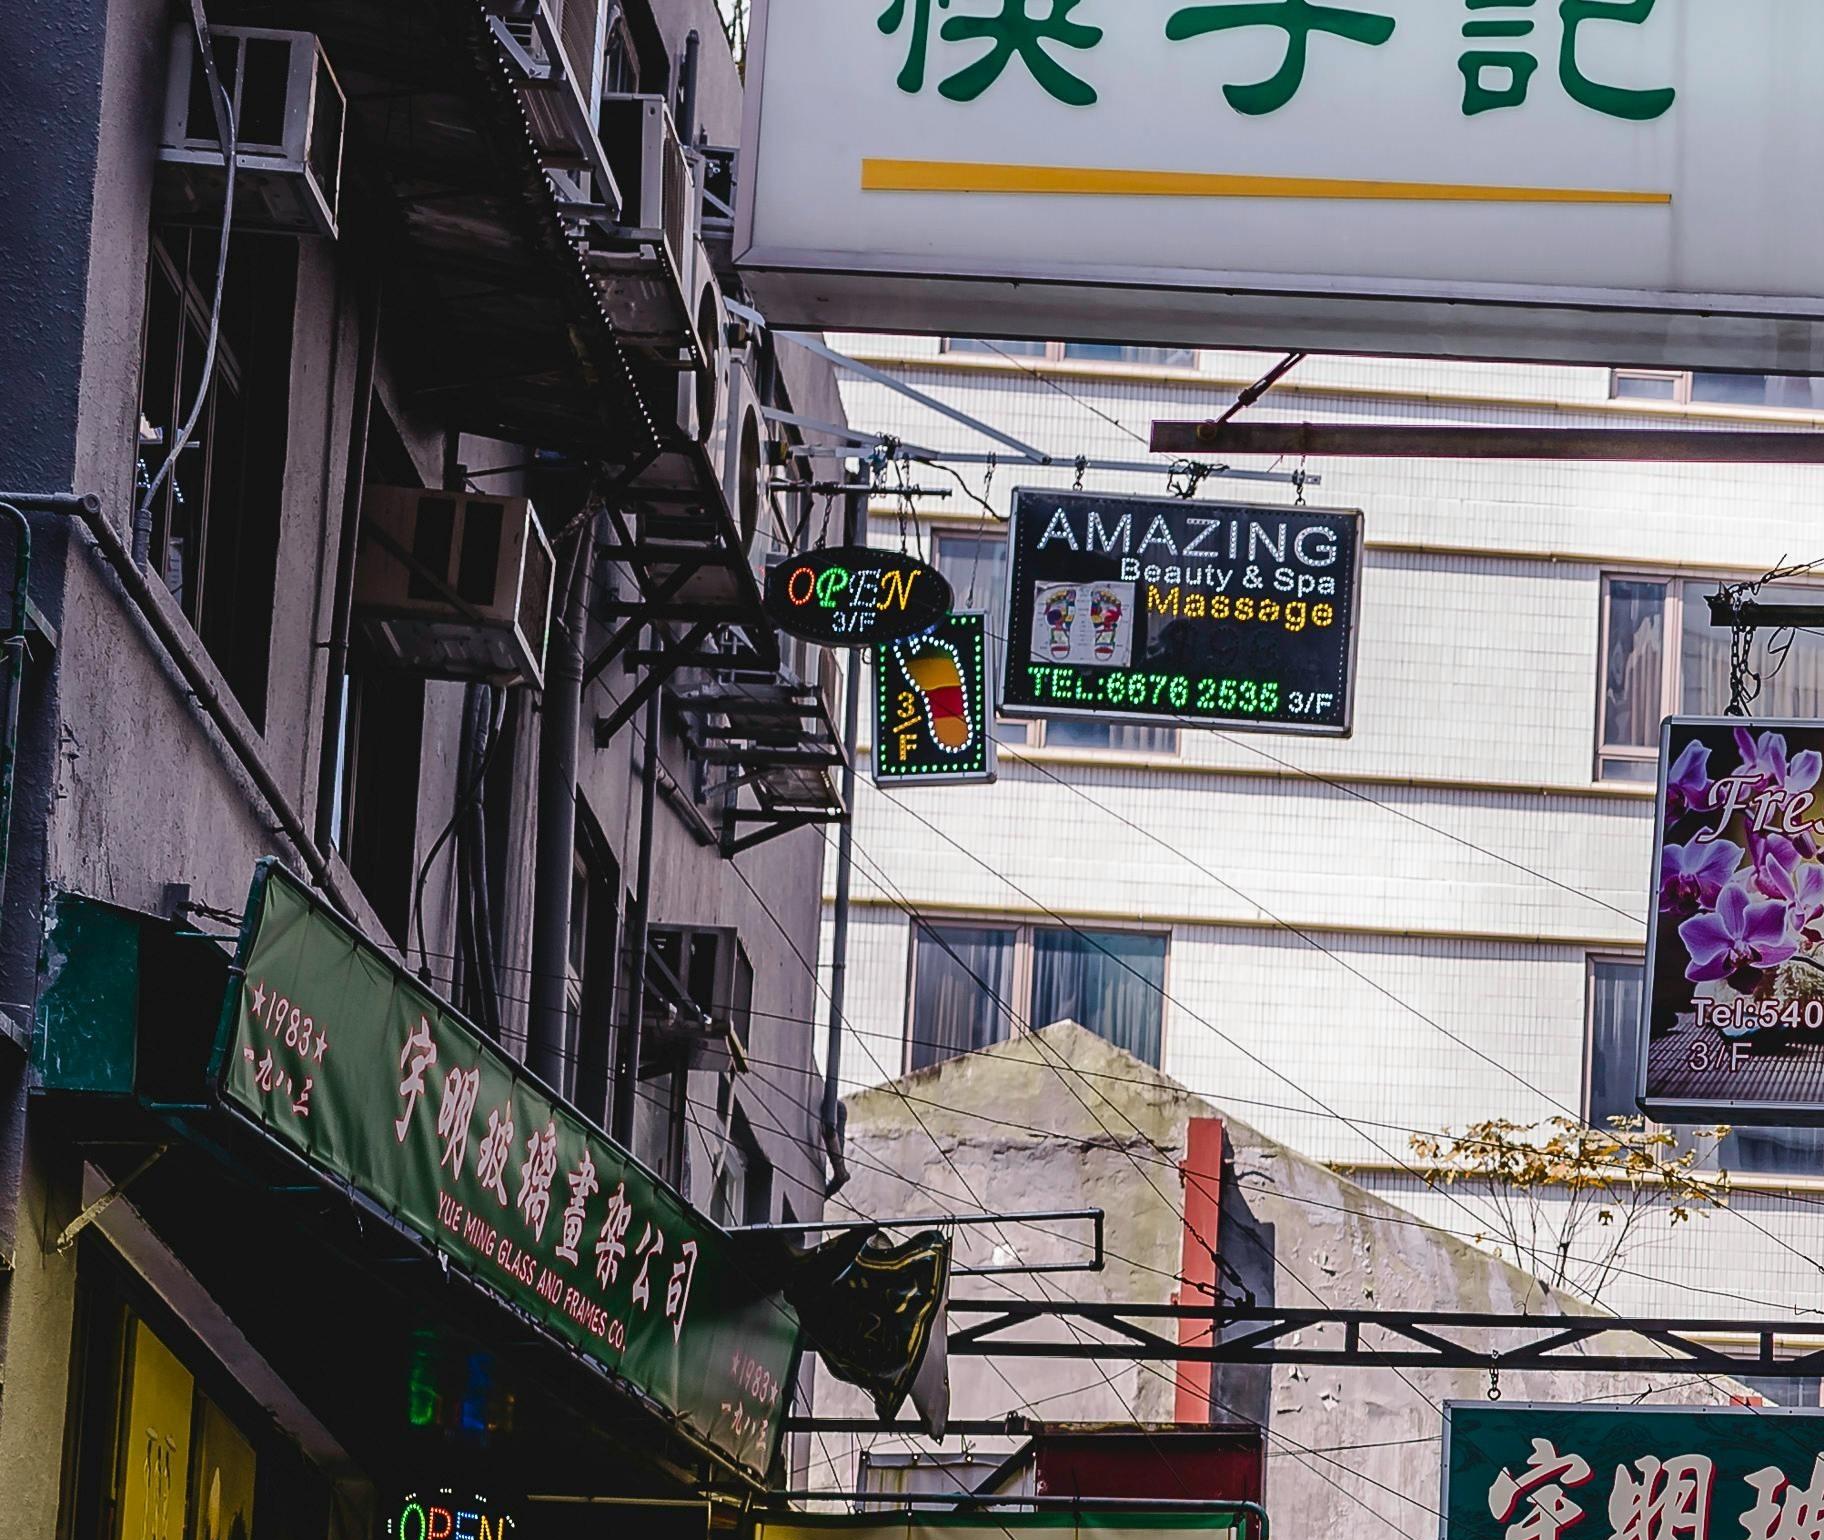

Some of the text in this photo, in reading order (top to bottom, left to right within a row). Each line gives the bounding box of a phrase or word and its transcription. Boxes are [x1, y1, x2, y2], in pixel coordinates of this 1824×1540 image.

[1037, 507, 1338, 567] AMAZING
[788, 567, 921, 611] OPEN
[1121, 558, 1335, 598] Beauty & Spa
[832, 611, 876, 632] 3/F
[1147, 586, 1333, 630] Massage
[1288, 691, 1333, 714] 3/F
[1689, 1042, 1752, 1072] 3/F
[395, 1016, 698, 1343] 宇明玻璃畫架公司
[437, 1193, 494, 1255] YUE MING
